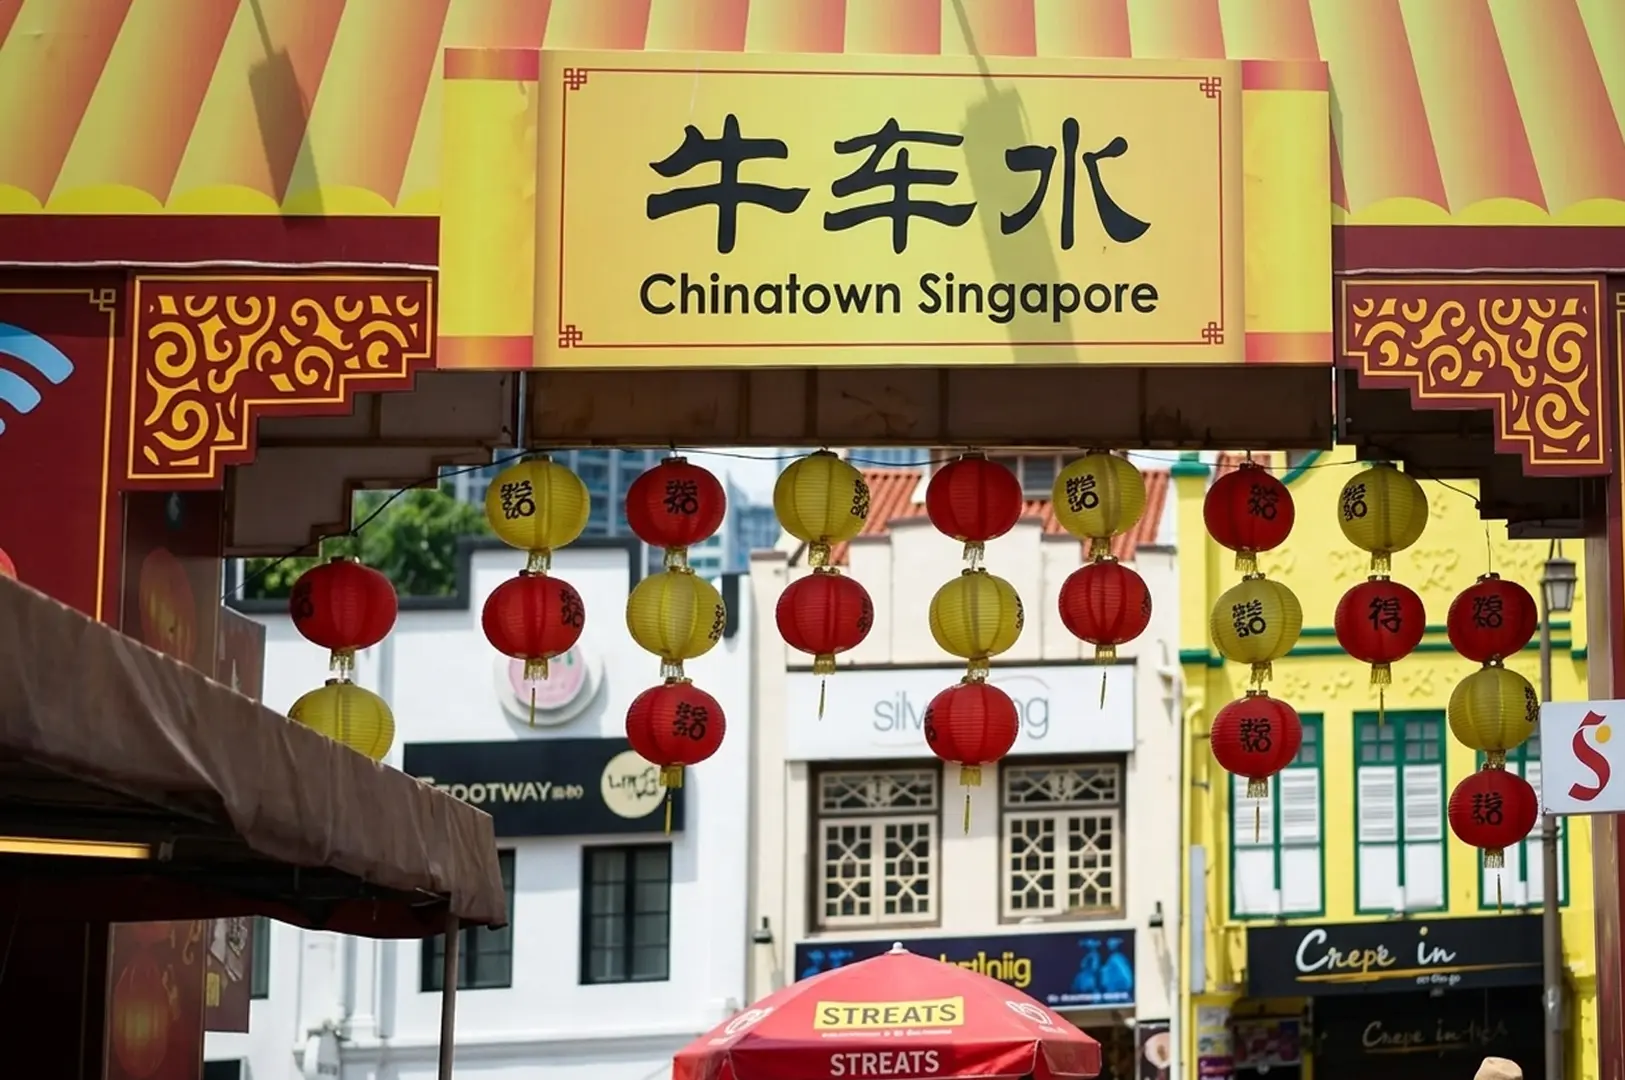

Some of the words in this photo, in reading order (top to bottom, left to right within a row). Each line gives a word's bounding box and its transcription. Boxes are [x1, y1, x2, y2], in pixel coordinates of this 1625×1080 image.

[646, 113, 1151, 254] 牛车水
[640, 271, 901, 315] Chinatown
[918, 271, 1159, 324] Singapore
[1416, 926, 1457, 965] in
[822, 1003, 957, 1026] STREATS
[830, 1049, 940, 1077] STREATS
